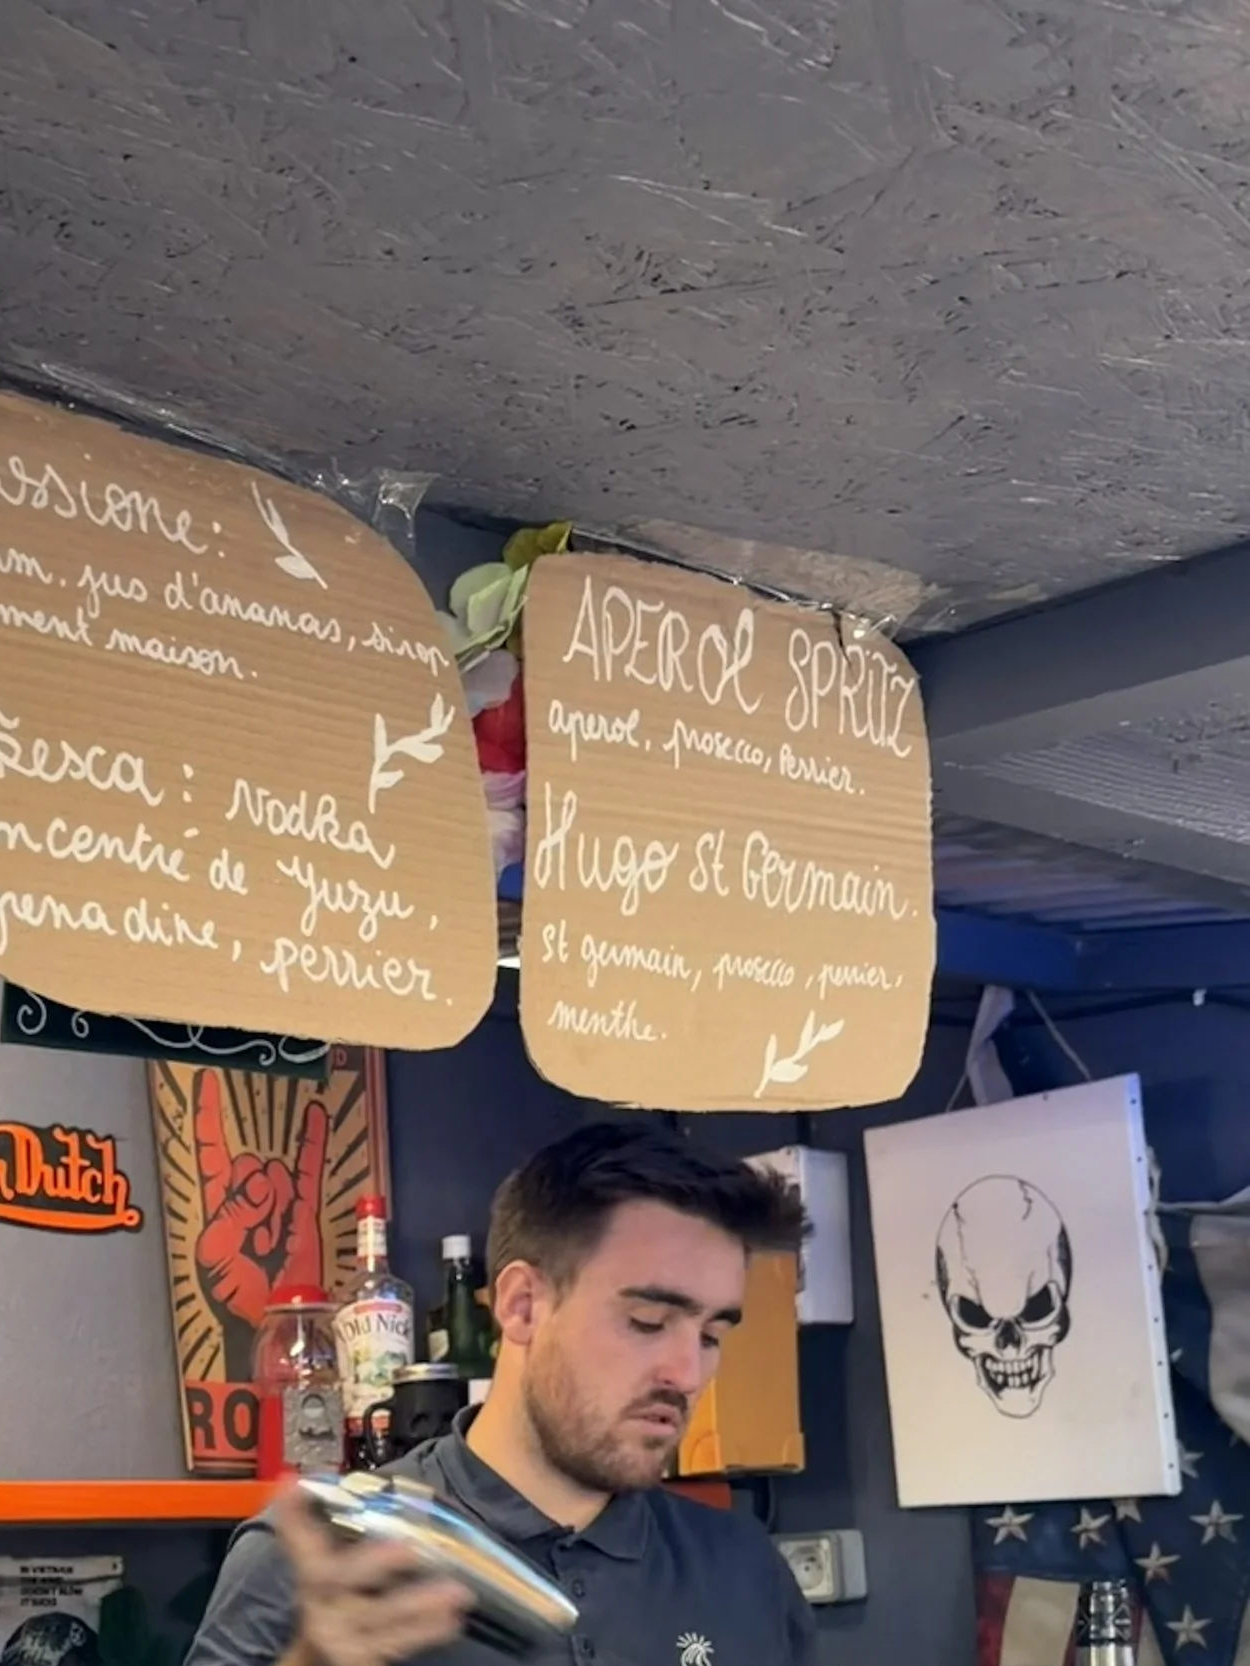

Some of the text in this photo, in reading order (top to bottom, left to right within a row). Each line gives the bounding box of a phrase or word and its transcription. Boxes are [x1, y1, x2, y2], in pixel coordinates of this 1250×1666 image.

[209, 848, 248, 896] de
[534, 782, 680, 916] Hugo
[689, 830, 730, 897] St
[191, 1390, 260, 1453] RO
